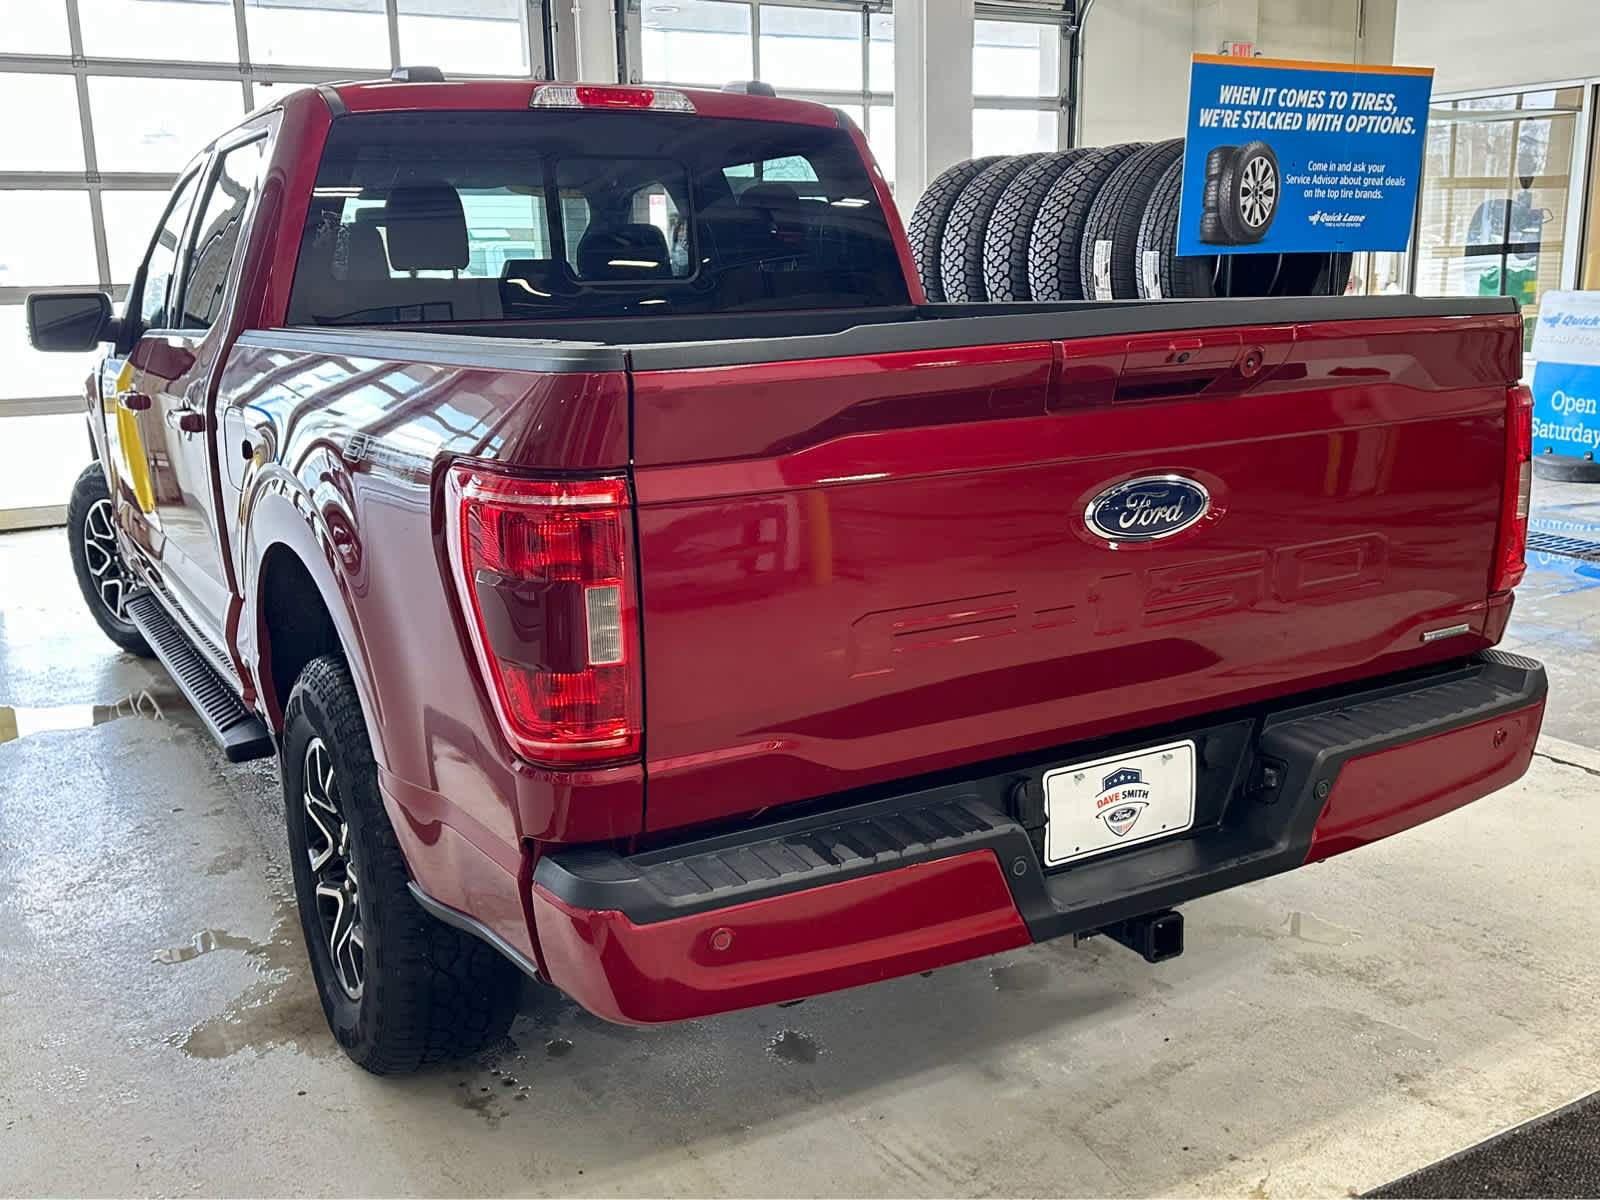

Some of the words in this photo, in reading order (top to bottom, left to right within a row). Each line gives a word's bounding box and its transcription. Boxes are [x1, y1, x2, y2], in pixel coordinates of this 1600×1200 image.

[1219, 84, 1261, 106] WHEN
[1261, 87, 1277, 106] IT
[1278, 88, 1326, 109] COMES
[1328, 91, 1348, 110] TO
[1350, 92, 1398, 115] TIRES,
[1199, 108, 1242, 128] WE'RE
[1241, 110, 1303, 131] STACKED
[1306, 113, 1344, 133] WITH
[1345, 115, 1417, 135] OPTIONS.
[1308, 160, 1328, 172] Come
[1329, 161, 1336, 172] in
[1337, 162, 1352, 172] and
[1353, 162, 1367, 173] ask
[1368, 164, 1386, 175] your
[1286, 174, 1311, 185] Service
[1312, 174, 1339, 185] Advisor
[1340, 175, 1362, 186] about
[1363, 176, 1384, 187] great
[1385, 176, 1406, 187] deals
[1304, 189, 1313, 198] on
[1314, 188, 1326, 198] the
[1327, 188, 1340, 200] top
[1341, 189, 1354, 199] tire
[1355, 189, 1384, 200] brands.
[1320, 212, 1343, 223] Quick
[1342, 212, 1366, 222] Lane
[1551, 390, 1597, 416] Open
[1119, 490, 1185, 528] Ford
[1096, 792, 1121, 809] DAVE
[1121, 789, 1150, 800] SMITH
